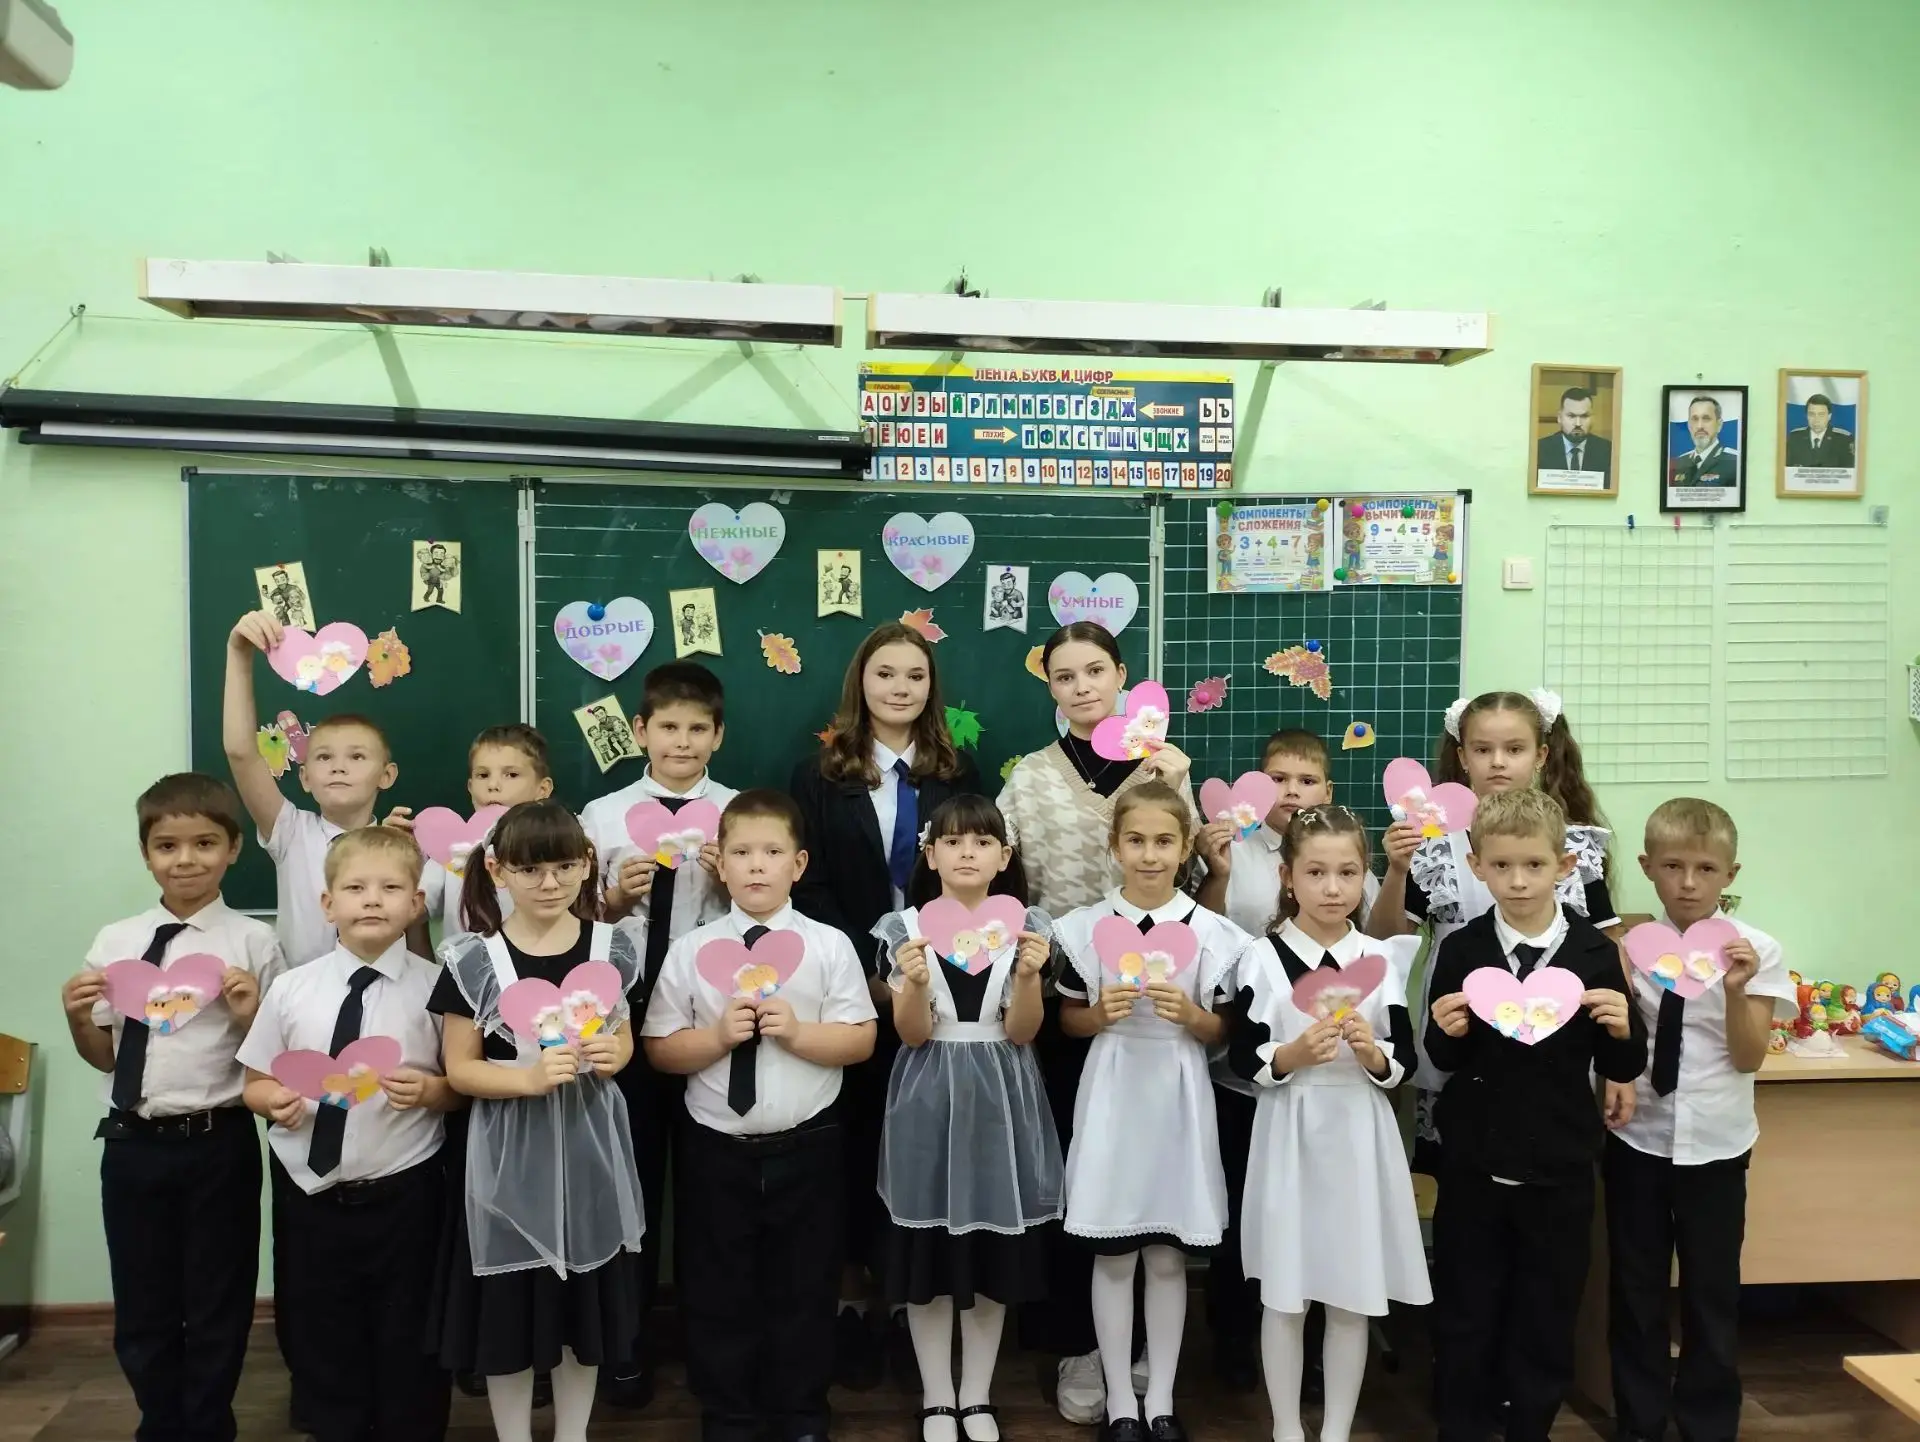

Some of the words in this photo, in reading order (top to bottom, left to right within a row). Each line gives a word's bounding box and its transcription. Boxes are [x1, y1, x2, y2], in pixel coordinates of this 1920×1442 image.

[974, 369, 1018, 380] ЛЕНТА
[1022, 369, 1057, 380] БУКВ
[1061, 370, 1070, 380] И
[1074, 370, 1114, 382] ЦИФР
[864, 395, 875, 411] А
[882, 396, 892, 412] О
[900, 396, 910, 412] У
[917, 396, 925, 412] Э
[932, 397, 946, 413] Ы
[952, 394, 963, 413] Й
[970, 397, 980, 414] Р
[986, 398, 997, 414] Л
[1004, 398, 1015, 414] М
[1021, 398, 1033, 415] Н
[1039, 399, 1050, 415] Б
[1056, 399, 1066, 416] В
[1075, 400, 1083, 416] Г
[1091, 400, 1100, 416] З
[1106, 401, 1118, 419] Д
[1121, 401, 1135, 418] Ж
[1153, 407, 1179, 415] ЗВОНКИЕ
[1219, 403, 1230, 418] Ъ
[882, 424, 890, 444] Ё
[897, 428, 911, 444] Ю
[918, 428, 926, 444] Е
[934, 428, 944, 444] И
[982, 431, 1005, 439] ГЛУХИЕ
[1025, 430, 1035, 446] П
[1040, 429, 1053, 445] Ф
[1059, 430, 1069, 446] К
[1077, 430, 1086, 446] С
[1094, 431, 1103, 447] Т
[1108, 431, 1120, 447] Ш
[1127, 432, 1137, 450] Ц
[1143, 432, 1152, 448] Ч
[1158, 432, 1171, 450] Щ
[1176, 432, 1187, 449] Х
[884, 463, 889, 475] 1
[901, 464, 909, 475] 2
[919, 464, 927, 475] 3
[937, 464, 945, 476] 4
[956, 464, 964, 476] 5
[973, 464, 981, 476] 6
[992, 465, 999, 477] 7
[1009, 465, 1017, 477] 8
[1027, 465, 1035, 478] 9
[1041, 465, 1055, 478] 10
[1060, 466, 1072, 479] 11
[1078, 466, 1091, 479] 12
[1095, 466, 1109, 479] 13
[1113, 467, 1126, 480] 14
[1130, 467, 1143, 480] 15
[1147, 467, 1160, 480] 16
[1165, 468, 1178, 481] 17
[1182, 468, 1195, 481] 18
[1200, 468, 1213, 481] 19
[1216, 469, 1231, 482] 20
[1361, 499, 1438, 510] КОМПОНЕНТЫ
[1232, 508, 1306, 520] КОМПОНЕНТЫ
[1238, 520, 1302, 531] СЛОЖЕНИЯ
[1370, 524, 1379, 536] 9
[1397, 523, 1406, 535] 4
[1422, 523, 1431, 535] 5
[696, 526, 778, 540] НЕЖНЫЕ
[888, 535, 970, 547] КРАСИВЫЕ
[1240, 536, 1250, 549] 3
[1267, 536, 1278, 549] 4
[1291, 535, 1302, 548] 7
[1061, 596, 1125, 609] УМНЫЕ
[564, 619, 646, 640] ДОБРЫЕ
